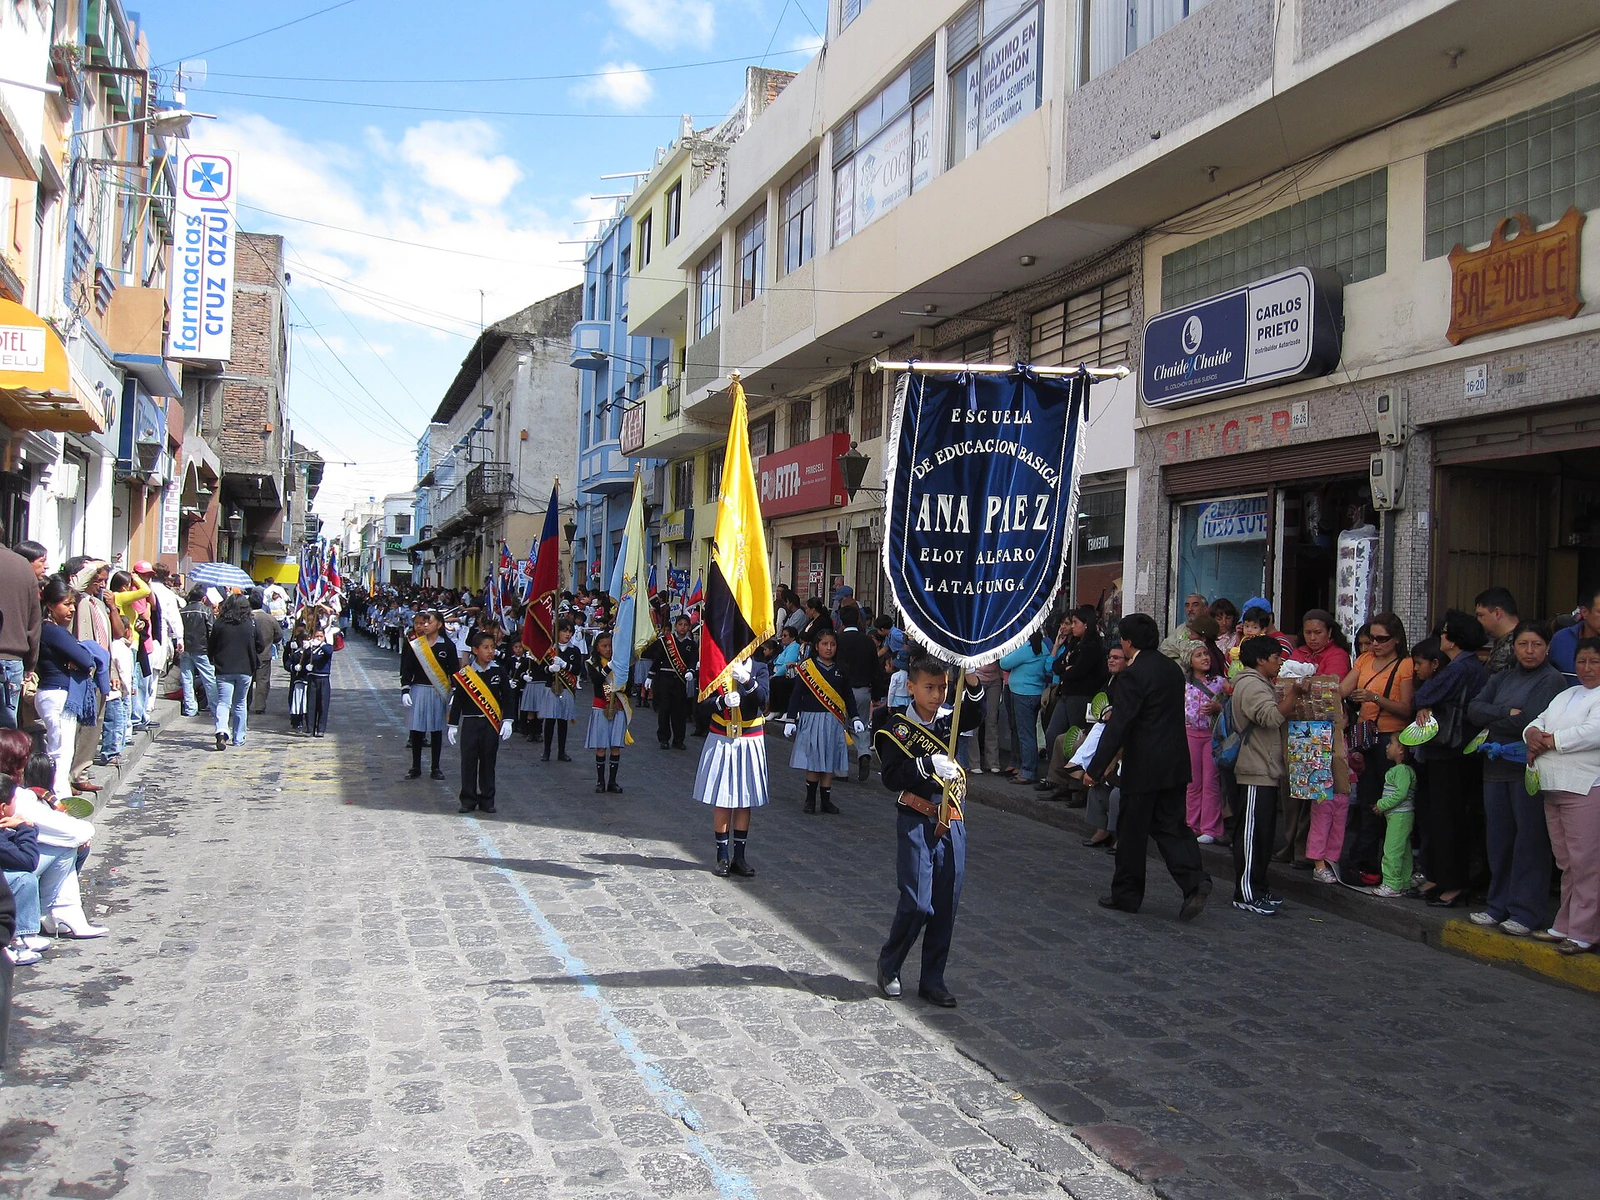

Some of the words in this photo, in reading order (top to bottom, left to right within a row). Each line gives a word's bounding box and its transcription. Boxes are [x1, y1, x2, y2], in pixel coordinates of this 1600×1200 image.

[983, 35, 1019, 79] MÁXIMO
[1022, 20, 1036, 45] EN
[200, 207, 229, 267] azul
[173, 214, 201, 352] farmacias
[1458, 265, 1496, 318] SAL
[1504, 242, 1567, 306] DULCE
[205, 277, 226, 336] cruz
[1256, 296, 1302, 321] CARLOS
[0, 331, 26, 352] TEL
[1257, 318, 1299, 341] PRIETO
[1153, 358, 1189, 381] Chaide
[1193, 347, 1232, 371] Chaide
[1254, 344, 1278, 355] Distribuidor
[1466, 378, 1485, 393] 16-20
[951, 408, 1032, 424] ESCUELA
[1163, 409, 1291, 465] SINGER
[913, 457, 934, 480] DE
[934, 438, 1019, 465] EDUCACION
[1017, 445, 1060, 489] BASICA
[761, 462, 801, 504] PORTA
[915, 493, 970, 534] ANA
[984, 493, 1050, 534] PAEZ
[919, 547, 965, 564] ELOY
[975, 547, 1036, 565] ALFARO
[924, 577, 1025, 595] LATACUNGA
